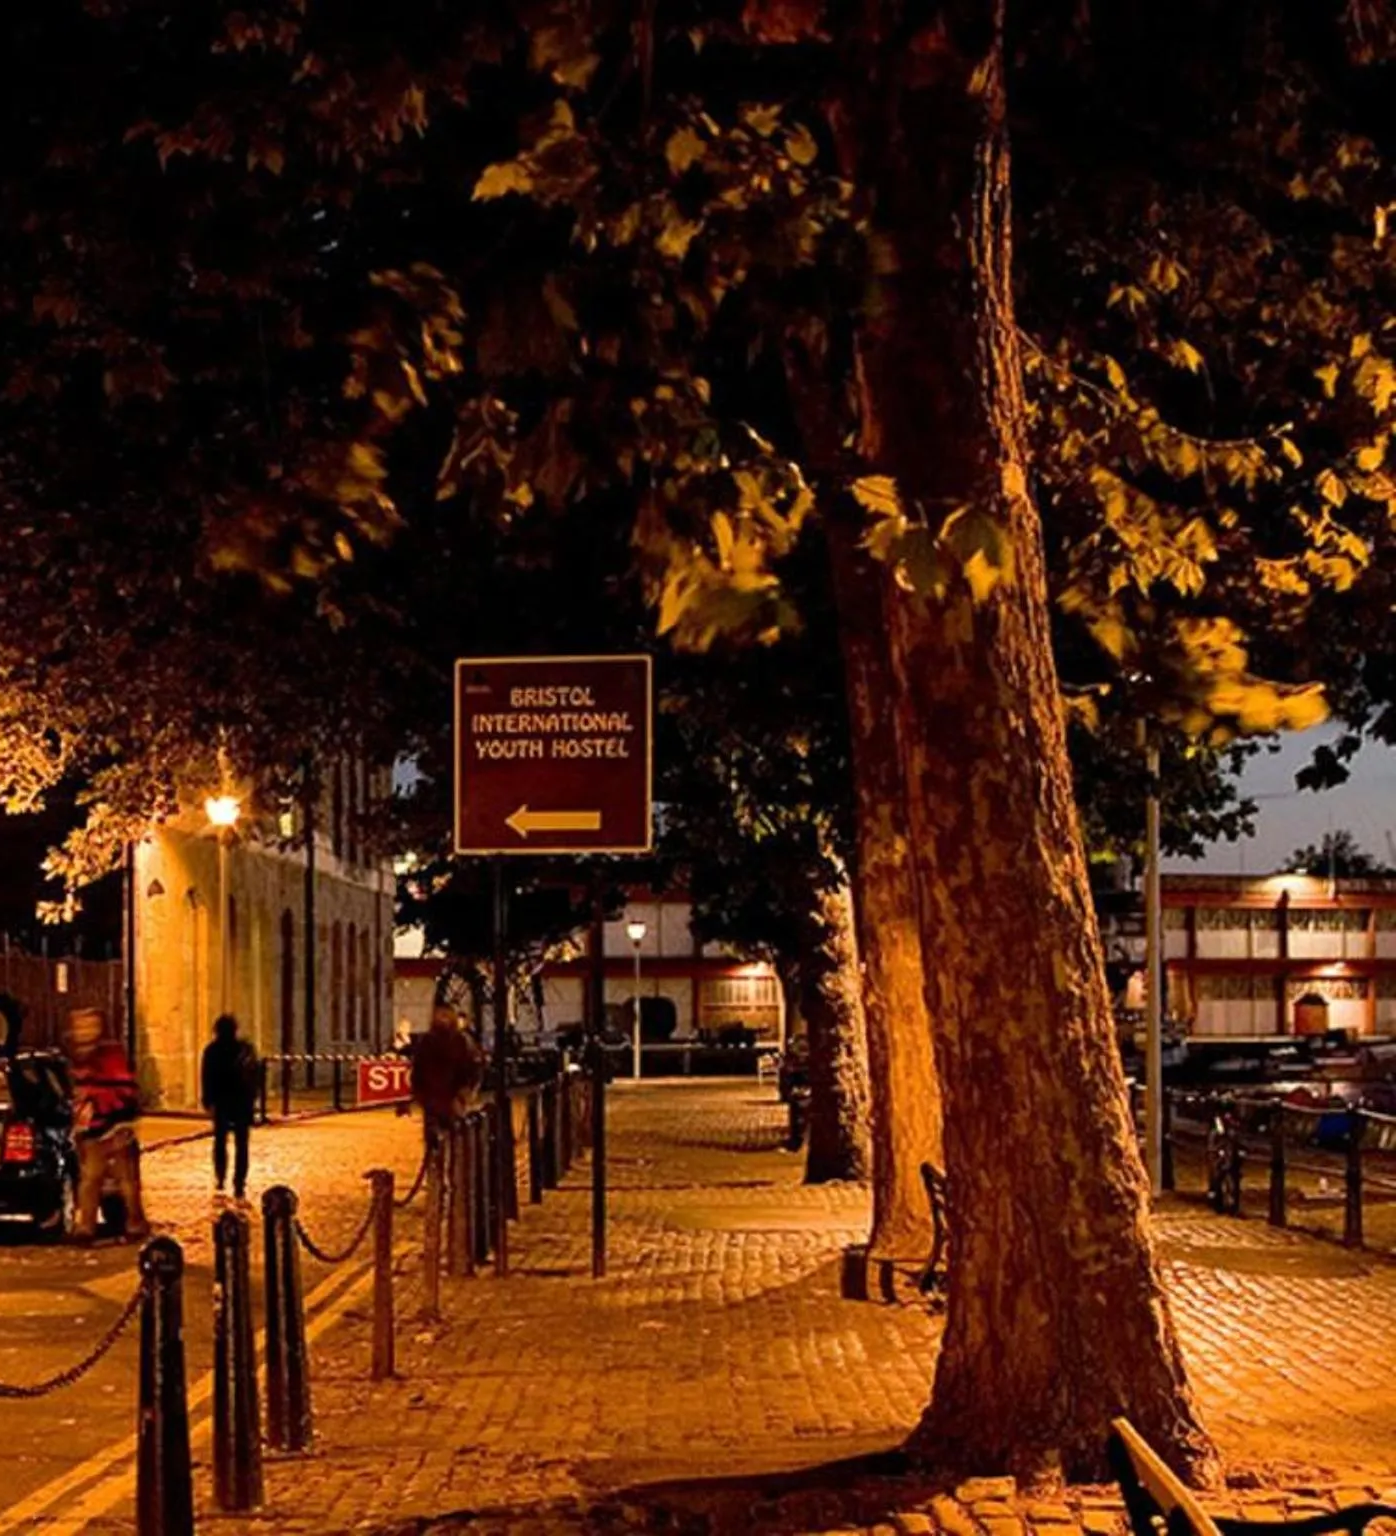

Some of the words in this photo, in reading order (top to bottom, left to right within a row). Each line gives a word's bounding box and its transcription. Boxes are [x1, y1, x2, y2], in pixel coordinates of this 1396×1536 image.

[510, 686, 596, 707] BRISTOL
[471, 712, 634, 733] INTERNATIONAL
[475, 739, 544, 759] YOUTH
[551, 738, 629, 758] HOSTEL
